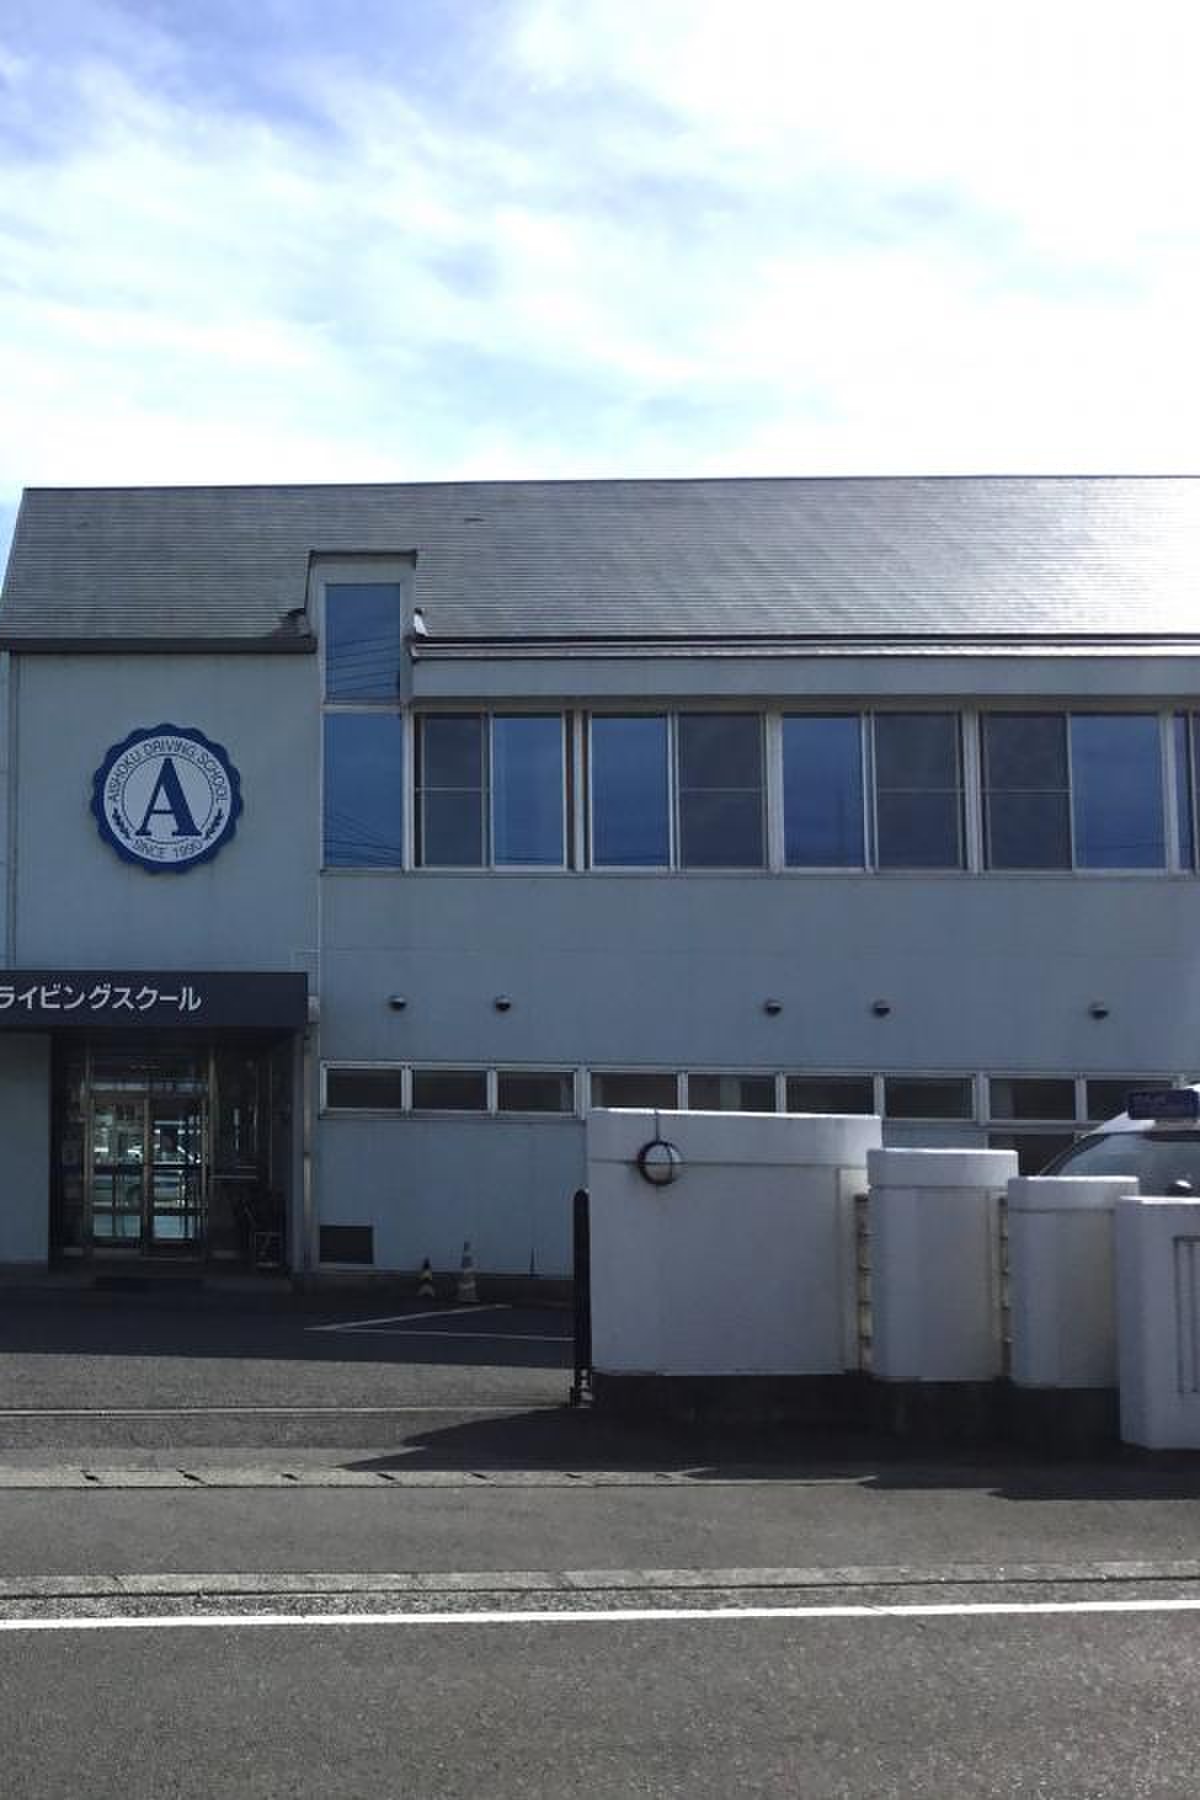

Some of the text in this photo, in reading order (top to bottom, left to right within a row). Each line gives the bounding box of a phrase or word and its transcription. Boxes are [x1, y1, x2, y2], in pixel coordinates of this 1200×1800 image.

[135, 757, 203, 836] A
[143, 740, 196, 756] DRIVING
[197, 753, 228, 804] SCHOOL
[133, 839, 165, 858] SINCE
